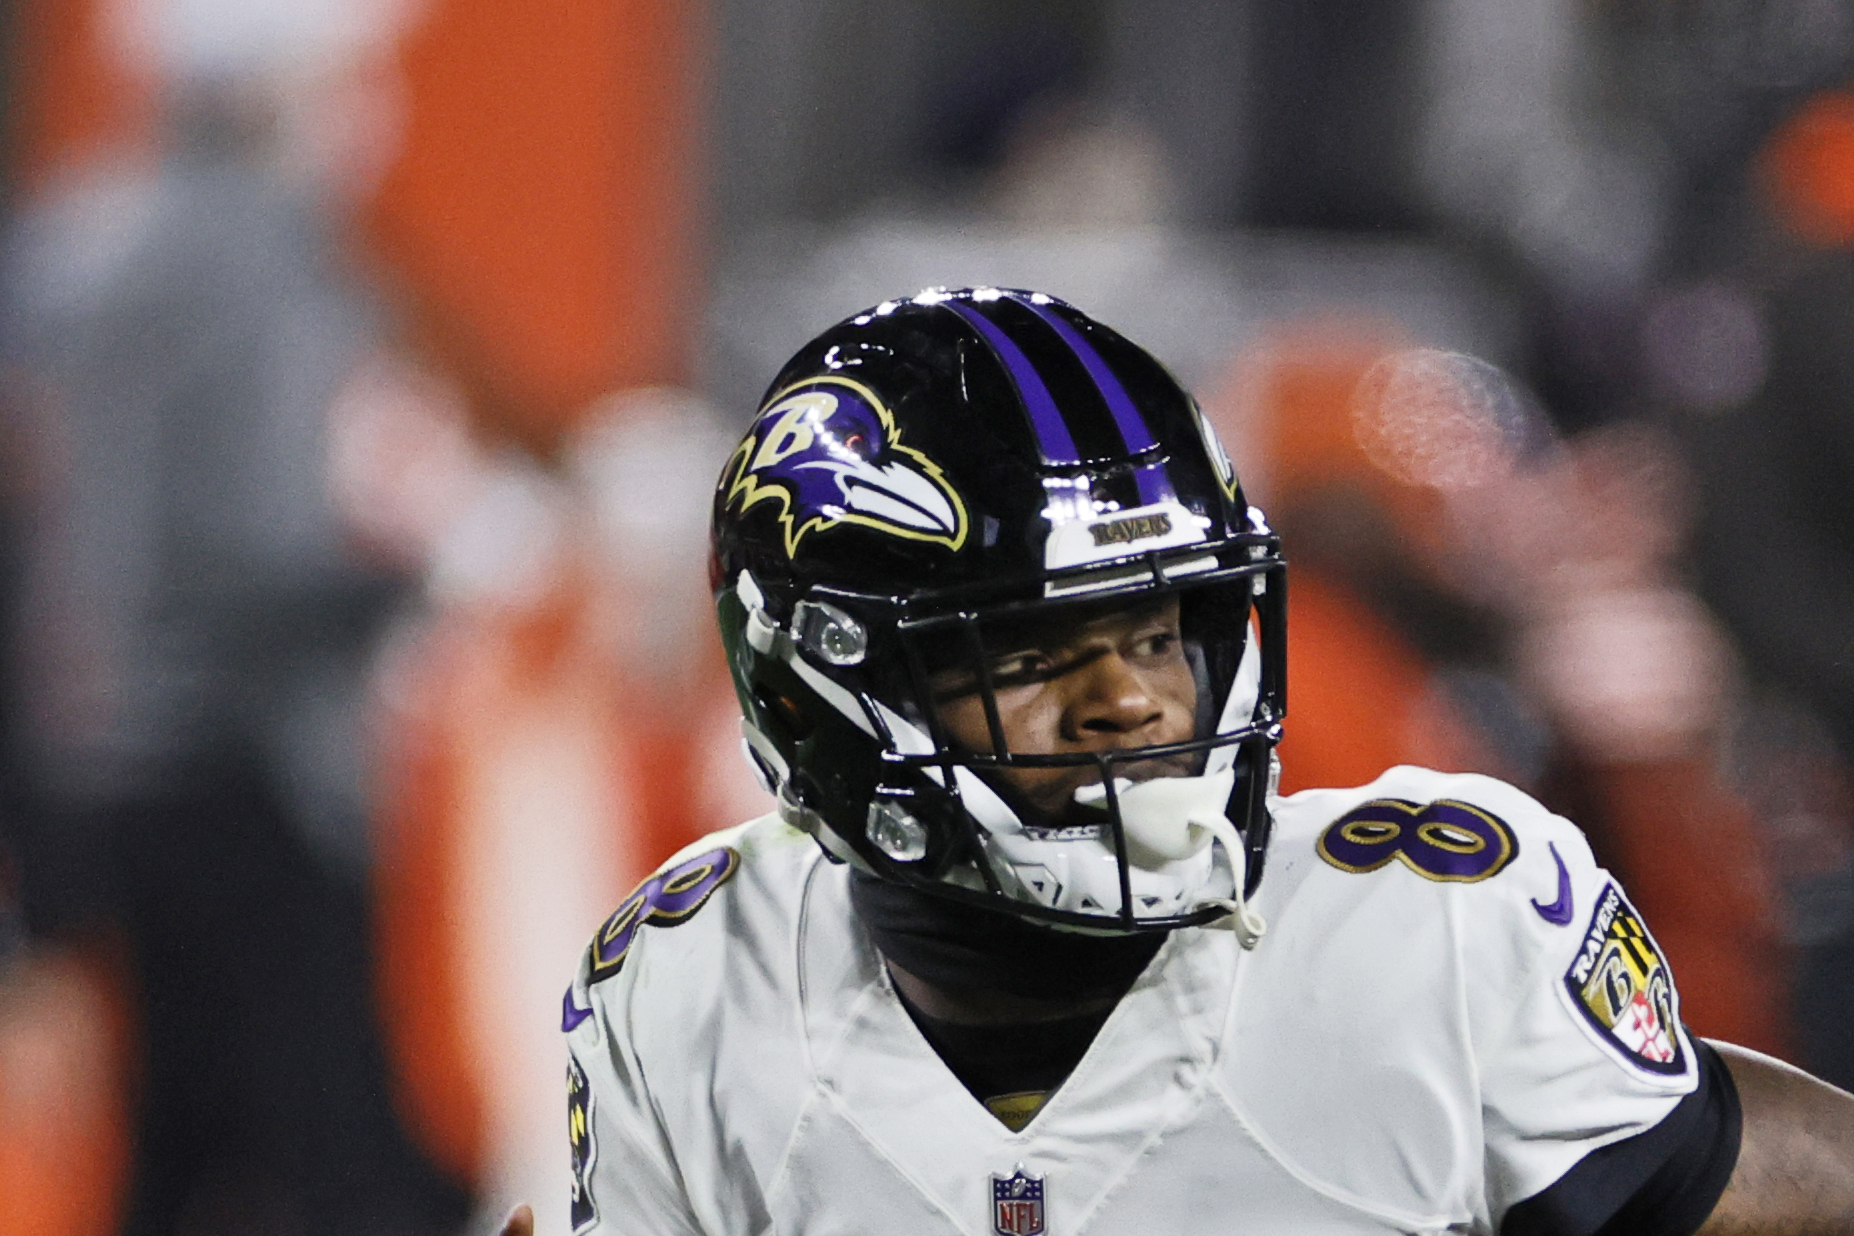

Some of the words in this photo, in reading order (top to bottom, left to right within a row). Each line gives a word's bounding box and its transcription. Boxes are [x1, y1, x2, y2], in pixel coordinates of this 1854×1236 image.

[1315, 797, 1520, 884] 8
[586, 845, 742, 986] 8
[1572, 887, 1621, 985] RAVENS
[999, 1202, 1041, 1235] NFL
